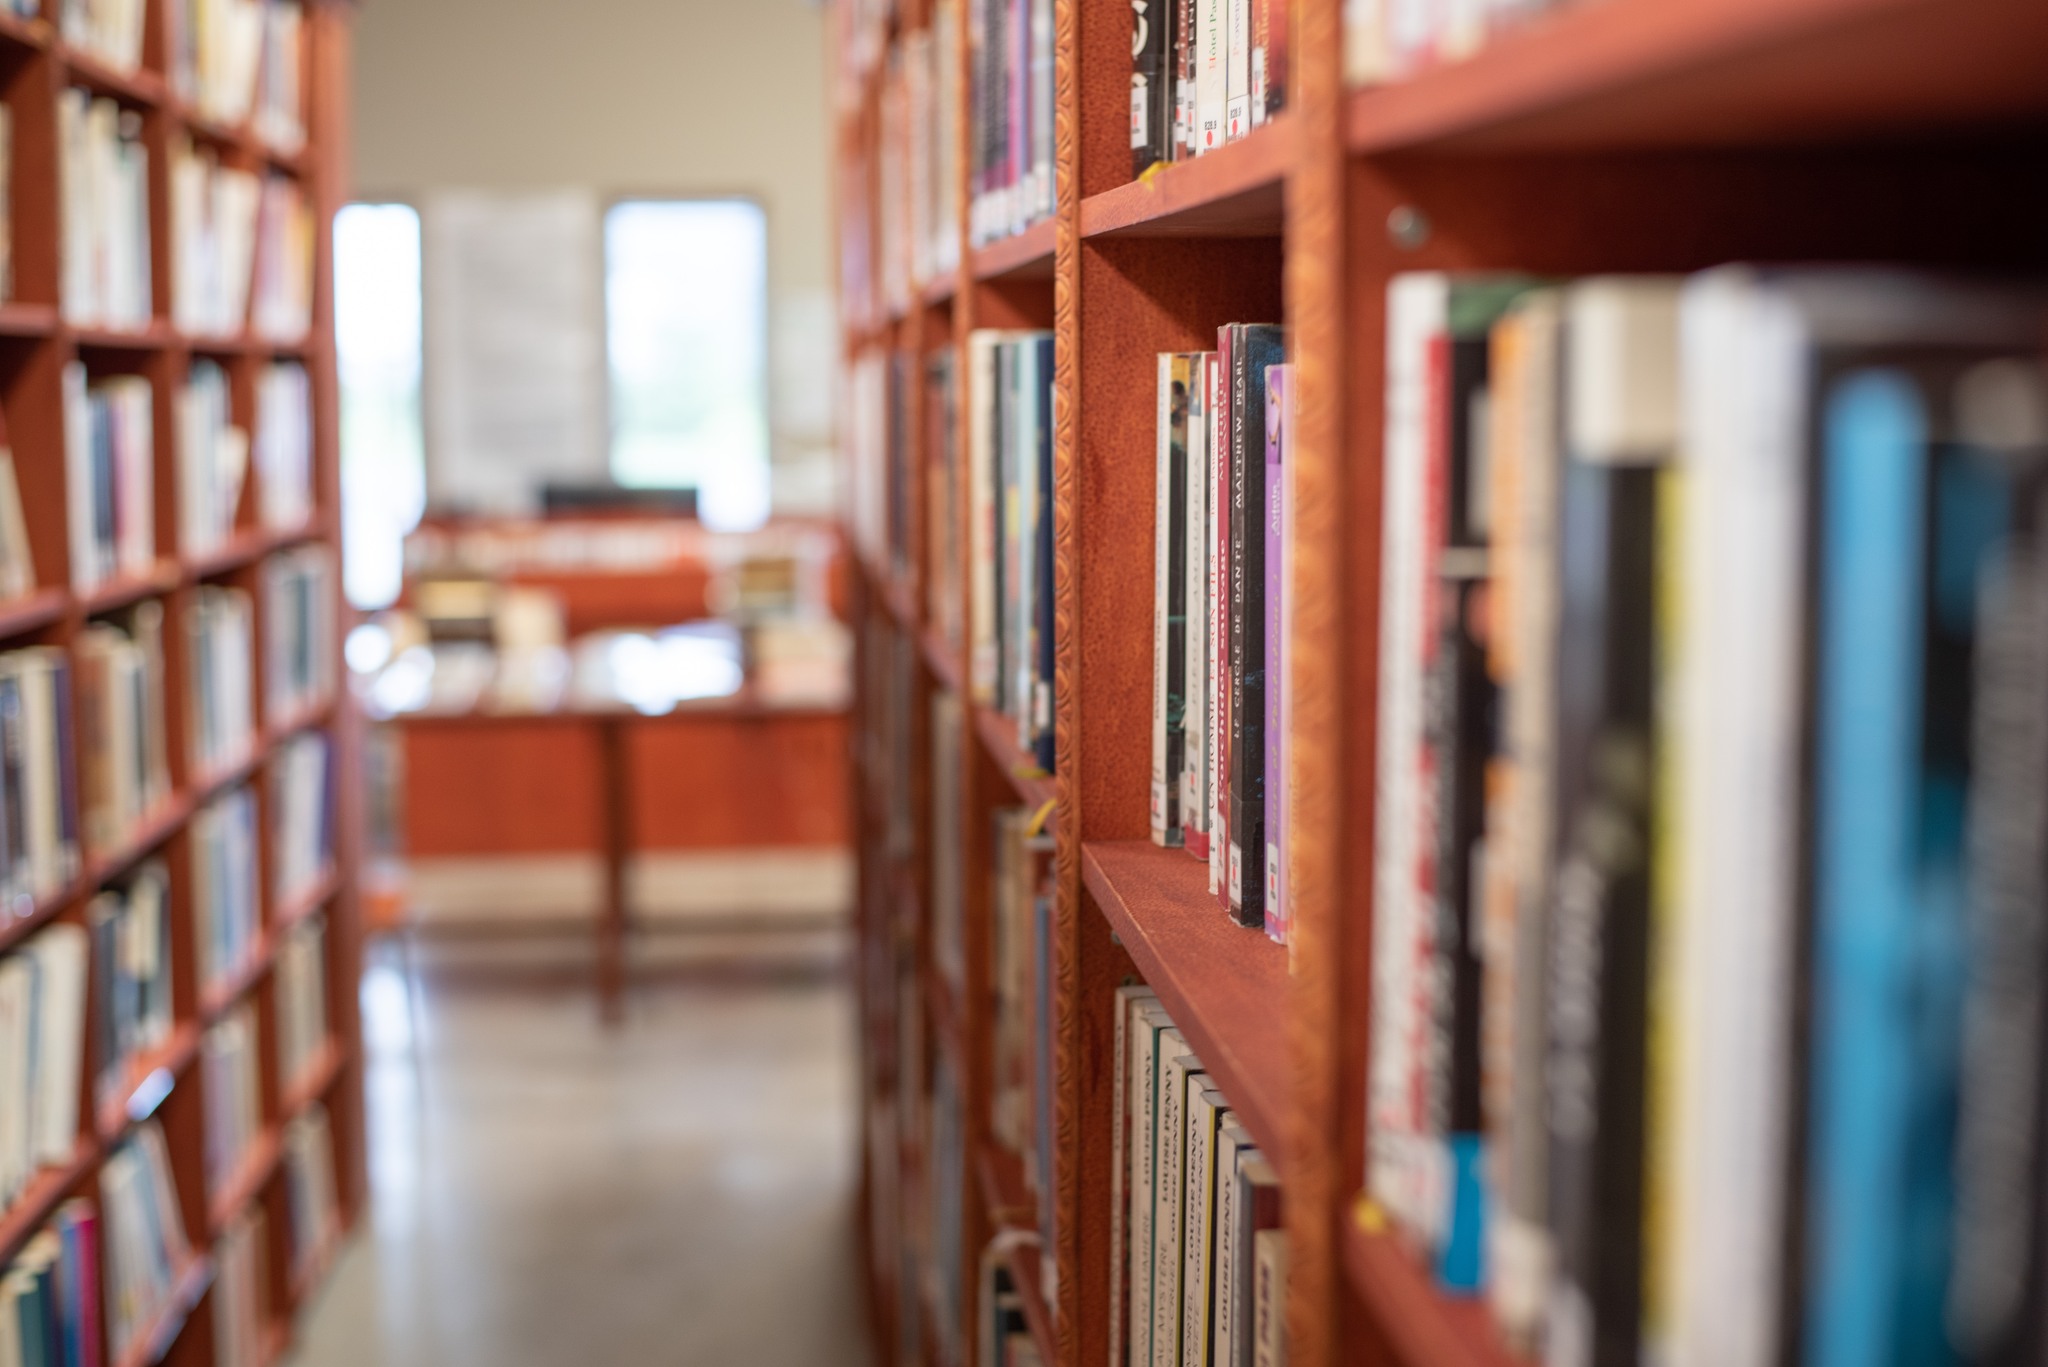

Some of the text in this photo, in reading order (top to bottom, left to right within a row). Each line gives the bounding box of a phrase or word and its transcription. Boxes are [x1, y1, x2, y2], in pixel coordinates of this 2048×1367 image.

[1234, 614, 1241, 634] DE
[1209, 657, 1215, 680] ET
[1234, 718, 1240, 739] LE
[1144, 1050, 1152, 1115] PENNY
[1161, 1064, 1172, 1203] LOUISE PENNY
[1188, 1112, 1198, 1260] LOUISE PENNY
[1221, 1175, 1231, 1334] LOUISE PENNY
